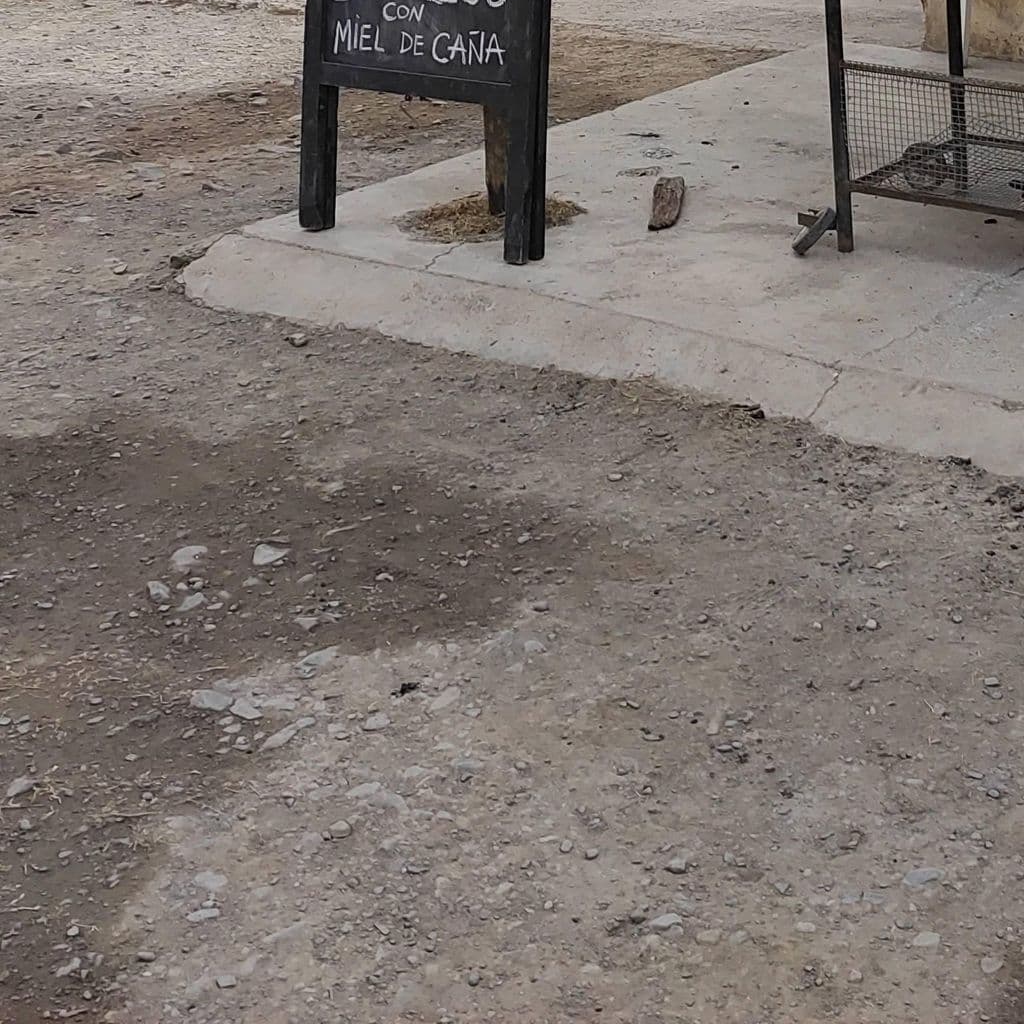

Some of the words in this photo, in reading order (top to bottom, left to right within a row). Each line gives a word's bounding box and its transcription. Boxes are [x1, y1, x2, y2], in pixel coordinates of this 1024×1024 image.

[382, 2, 425, 22] CON
[334, 14, 384, 54] MIEL
[400, 31, 424, 56] DE
[432, 30, 506, 66] CAÑA
